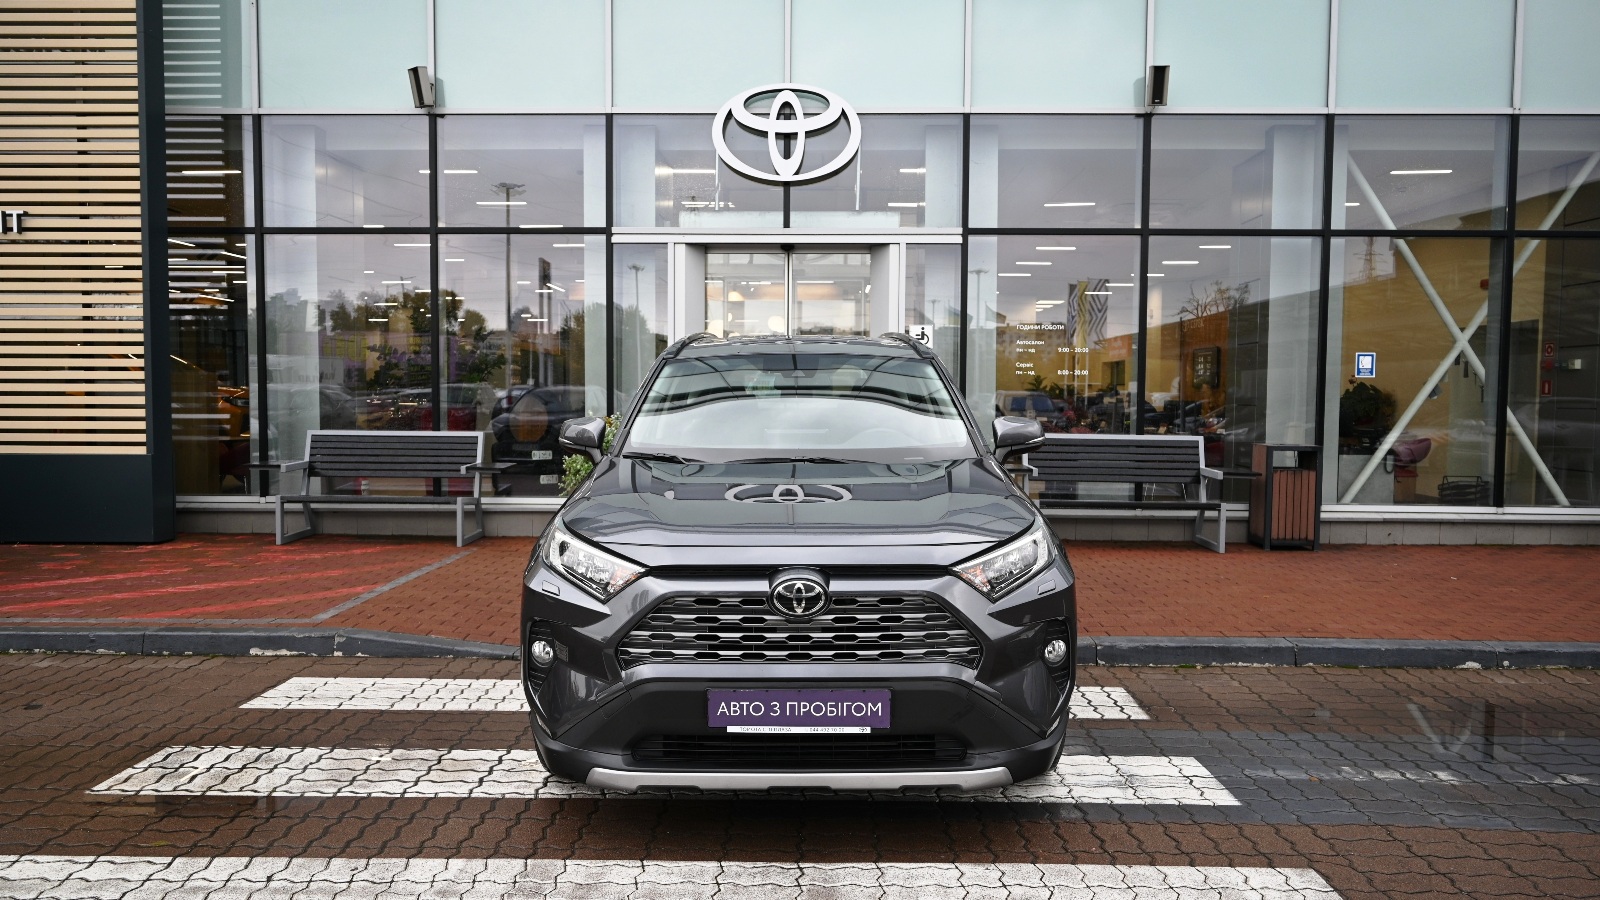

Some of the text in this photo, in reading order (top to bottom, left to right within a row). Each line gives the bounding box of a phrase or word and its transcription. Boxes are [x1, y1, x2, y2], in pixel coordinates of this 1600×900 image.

[716, 701, 883, 717] АВТО З ПРОБІГОМ
